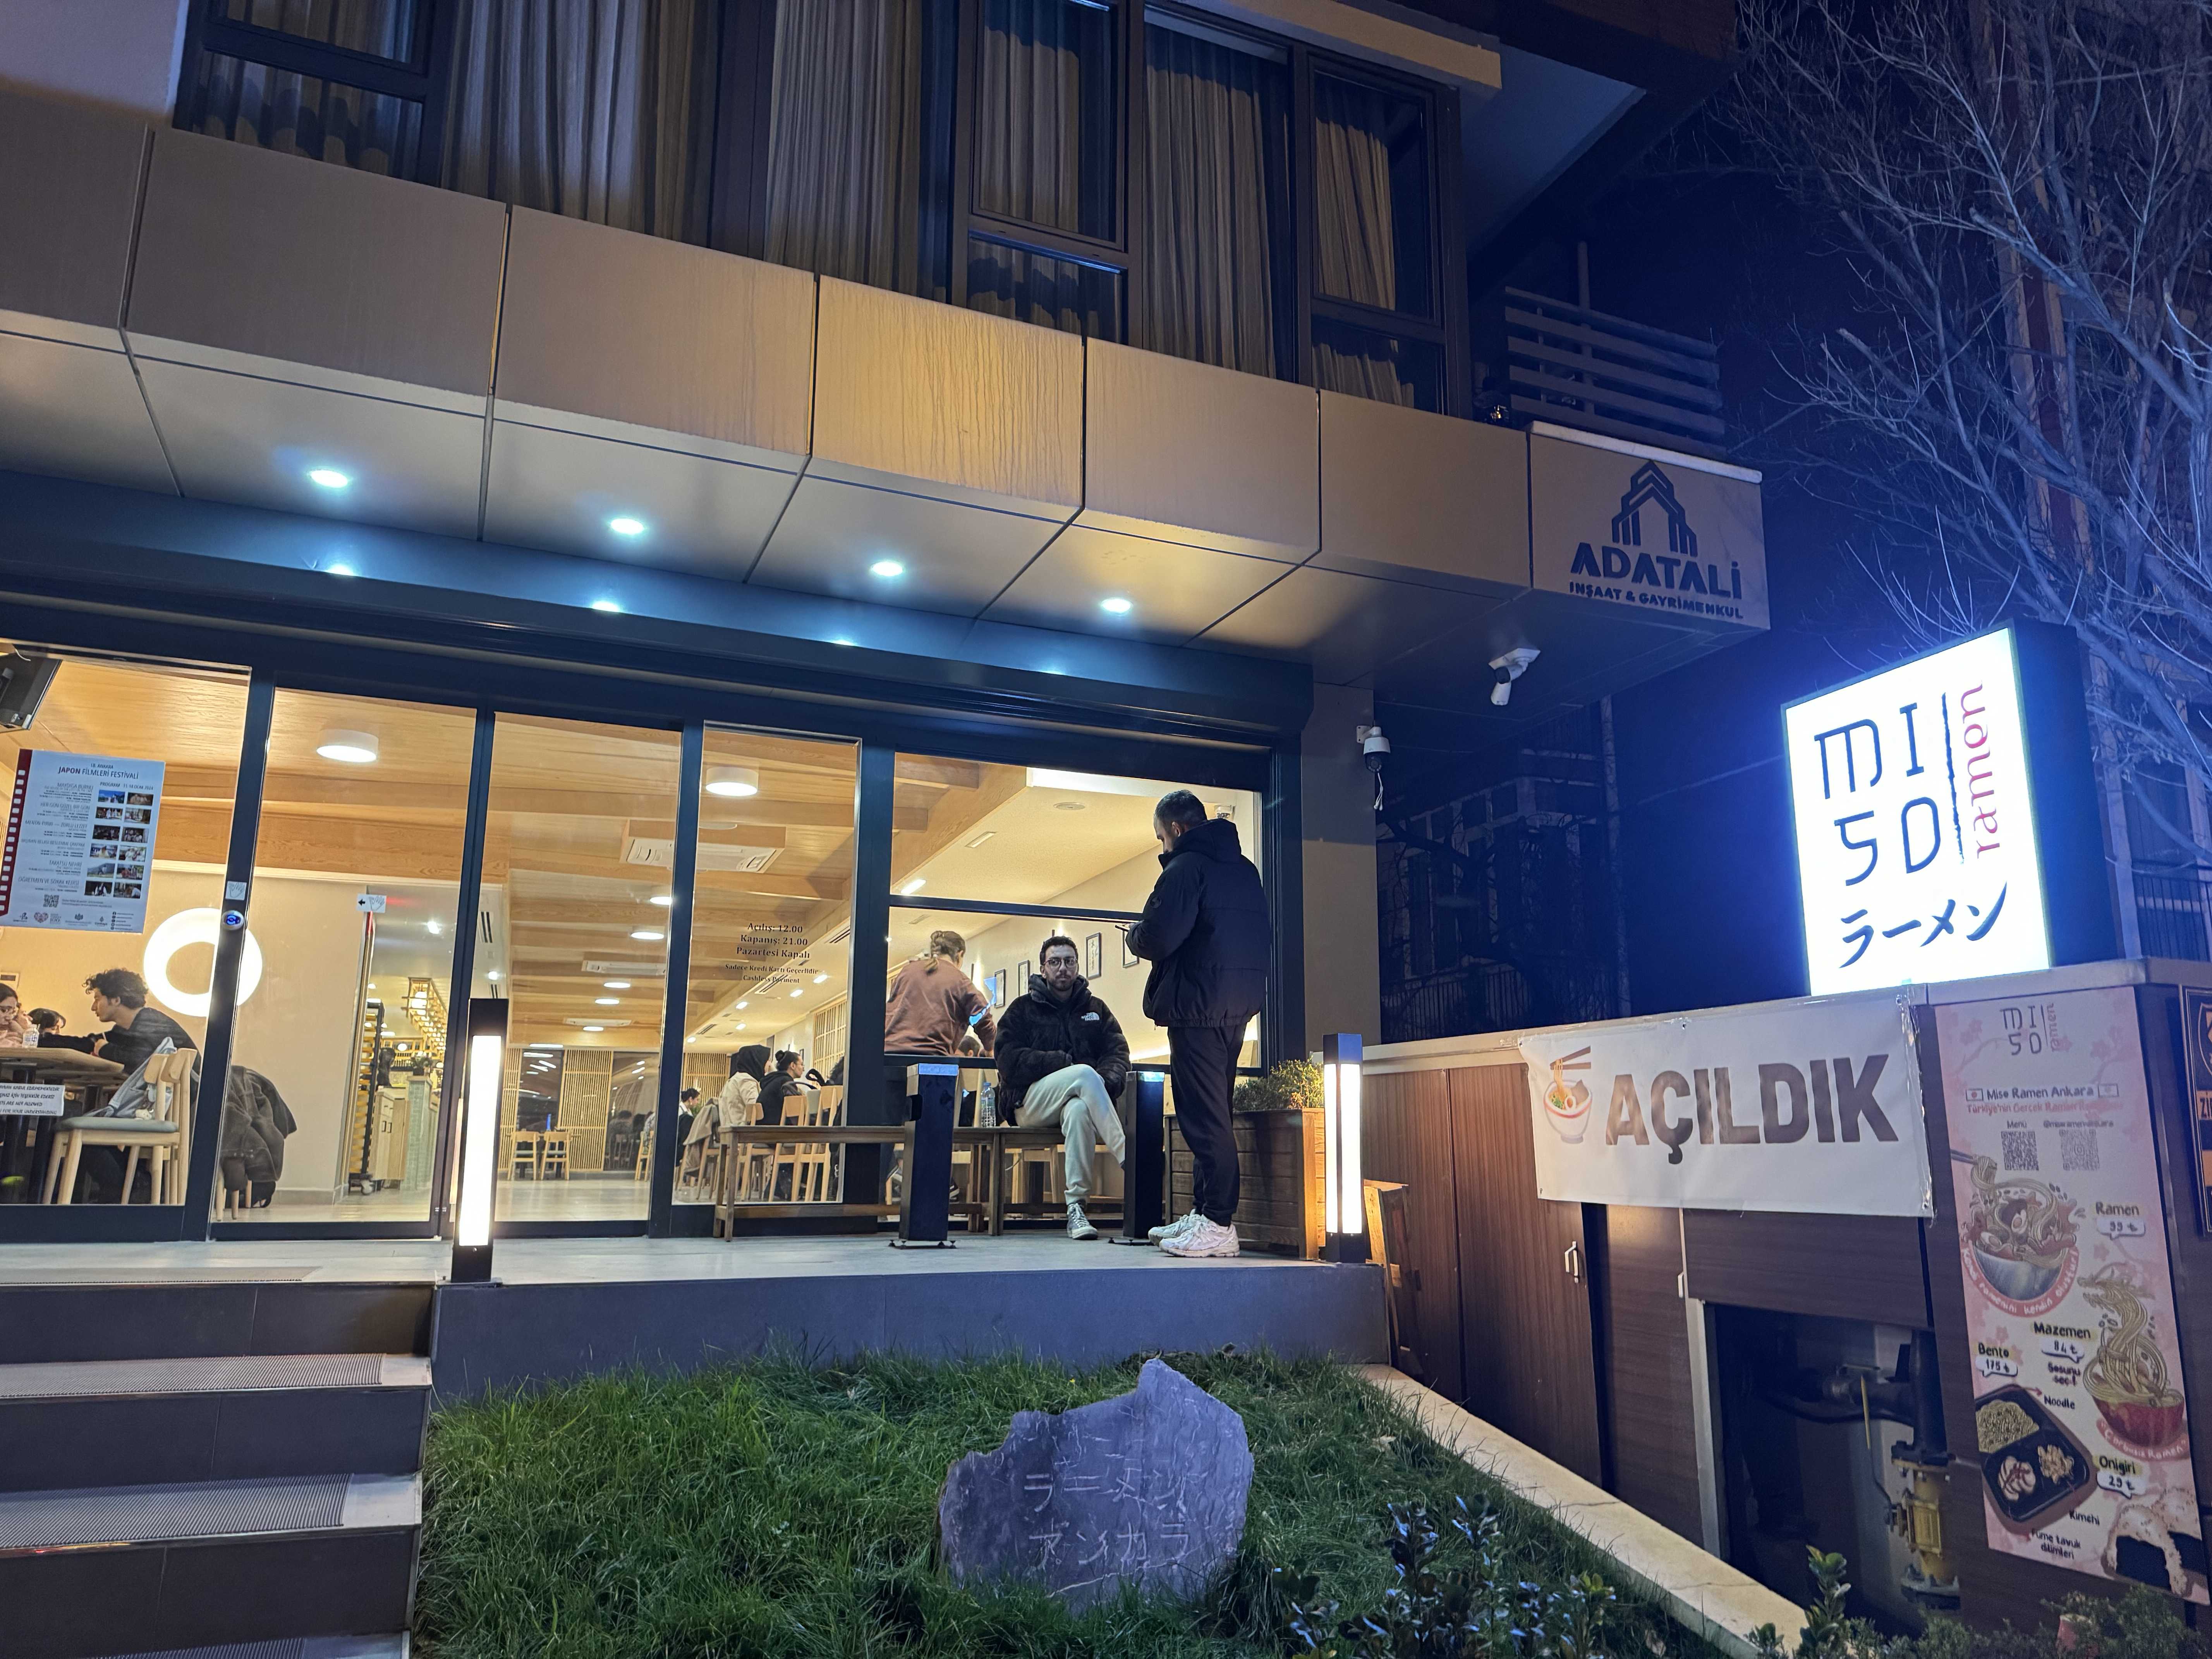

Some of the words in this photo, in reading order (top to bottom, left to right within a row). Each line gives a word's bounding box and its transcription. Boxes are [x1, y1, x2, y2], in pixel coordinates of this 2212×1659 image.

[1571, 542, 1742, 599] ADATALİ
[1626, 591, 1635, 603] &
[1639, 592, 1743, 619] GAYRİMENKUL
[58, 766, 81, 775] JAPON
[82, 767, 109, 777] FİLMLERİ
[111, 771, 139, 779] FESTİVALİ
[747, 923, 775, 933] Açılış:
[778, 925, 803, 933] 12.00
[1839, 881, 2008, 969] ラーメン
[741, 934, 780, 945] Kapanış:
[783, 938, 808, 946] 21.00
[737, 947, 779, 957] Pazartesi
[781, 950, 810, 959] Kapalı
[1987, 1089, 2009, 1101] Miso
[2012, 1087, 2049, 1099] Ramen
[2051, 1085, 2094, 1098] Ankara
[1606, 1054, 1899, 1164] AÇILDIK
[2033, 1321, 2091, 1339] Mazemen
[1978, 1341, 2009, 1358] Bento
[2044, 1395, 2075, 1410] Noodle
[2099, 1455, 2136, 1475] Onigiri
[2109, 1474, 2123, 1488] 29
[2069, 1510, 2100, 1526] Kimchi
[2056, 1534, 2081, 1549] tavuk
